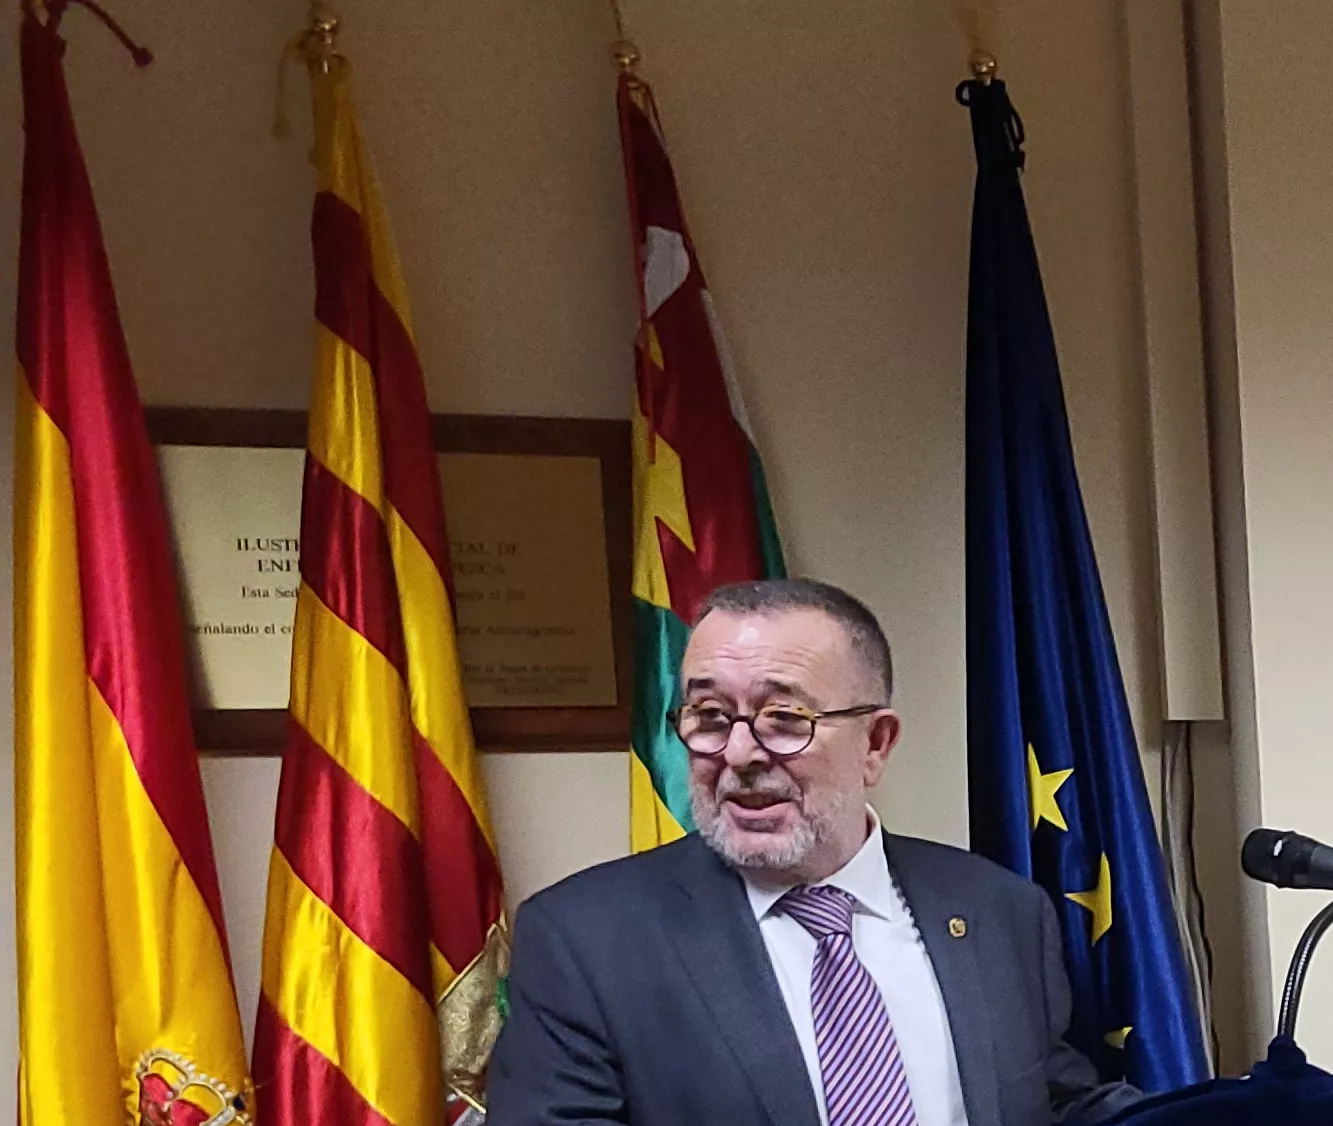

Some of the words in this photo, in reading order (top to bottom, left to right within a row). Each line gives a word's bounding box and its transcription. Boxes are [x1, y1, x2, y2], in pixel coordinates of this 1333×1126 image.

[258, 559, 301, 572] ENF
[242, 586, 269, 598] Esta
[264, 623, 275, 634] el
